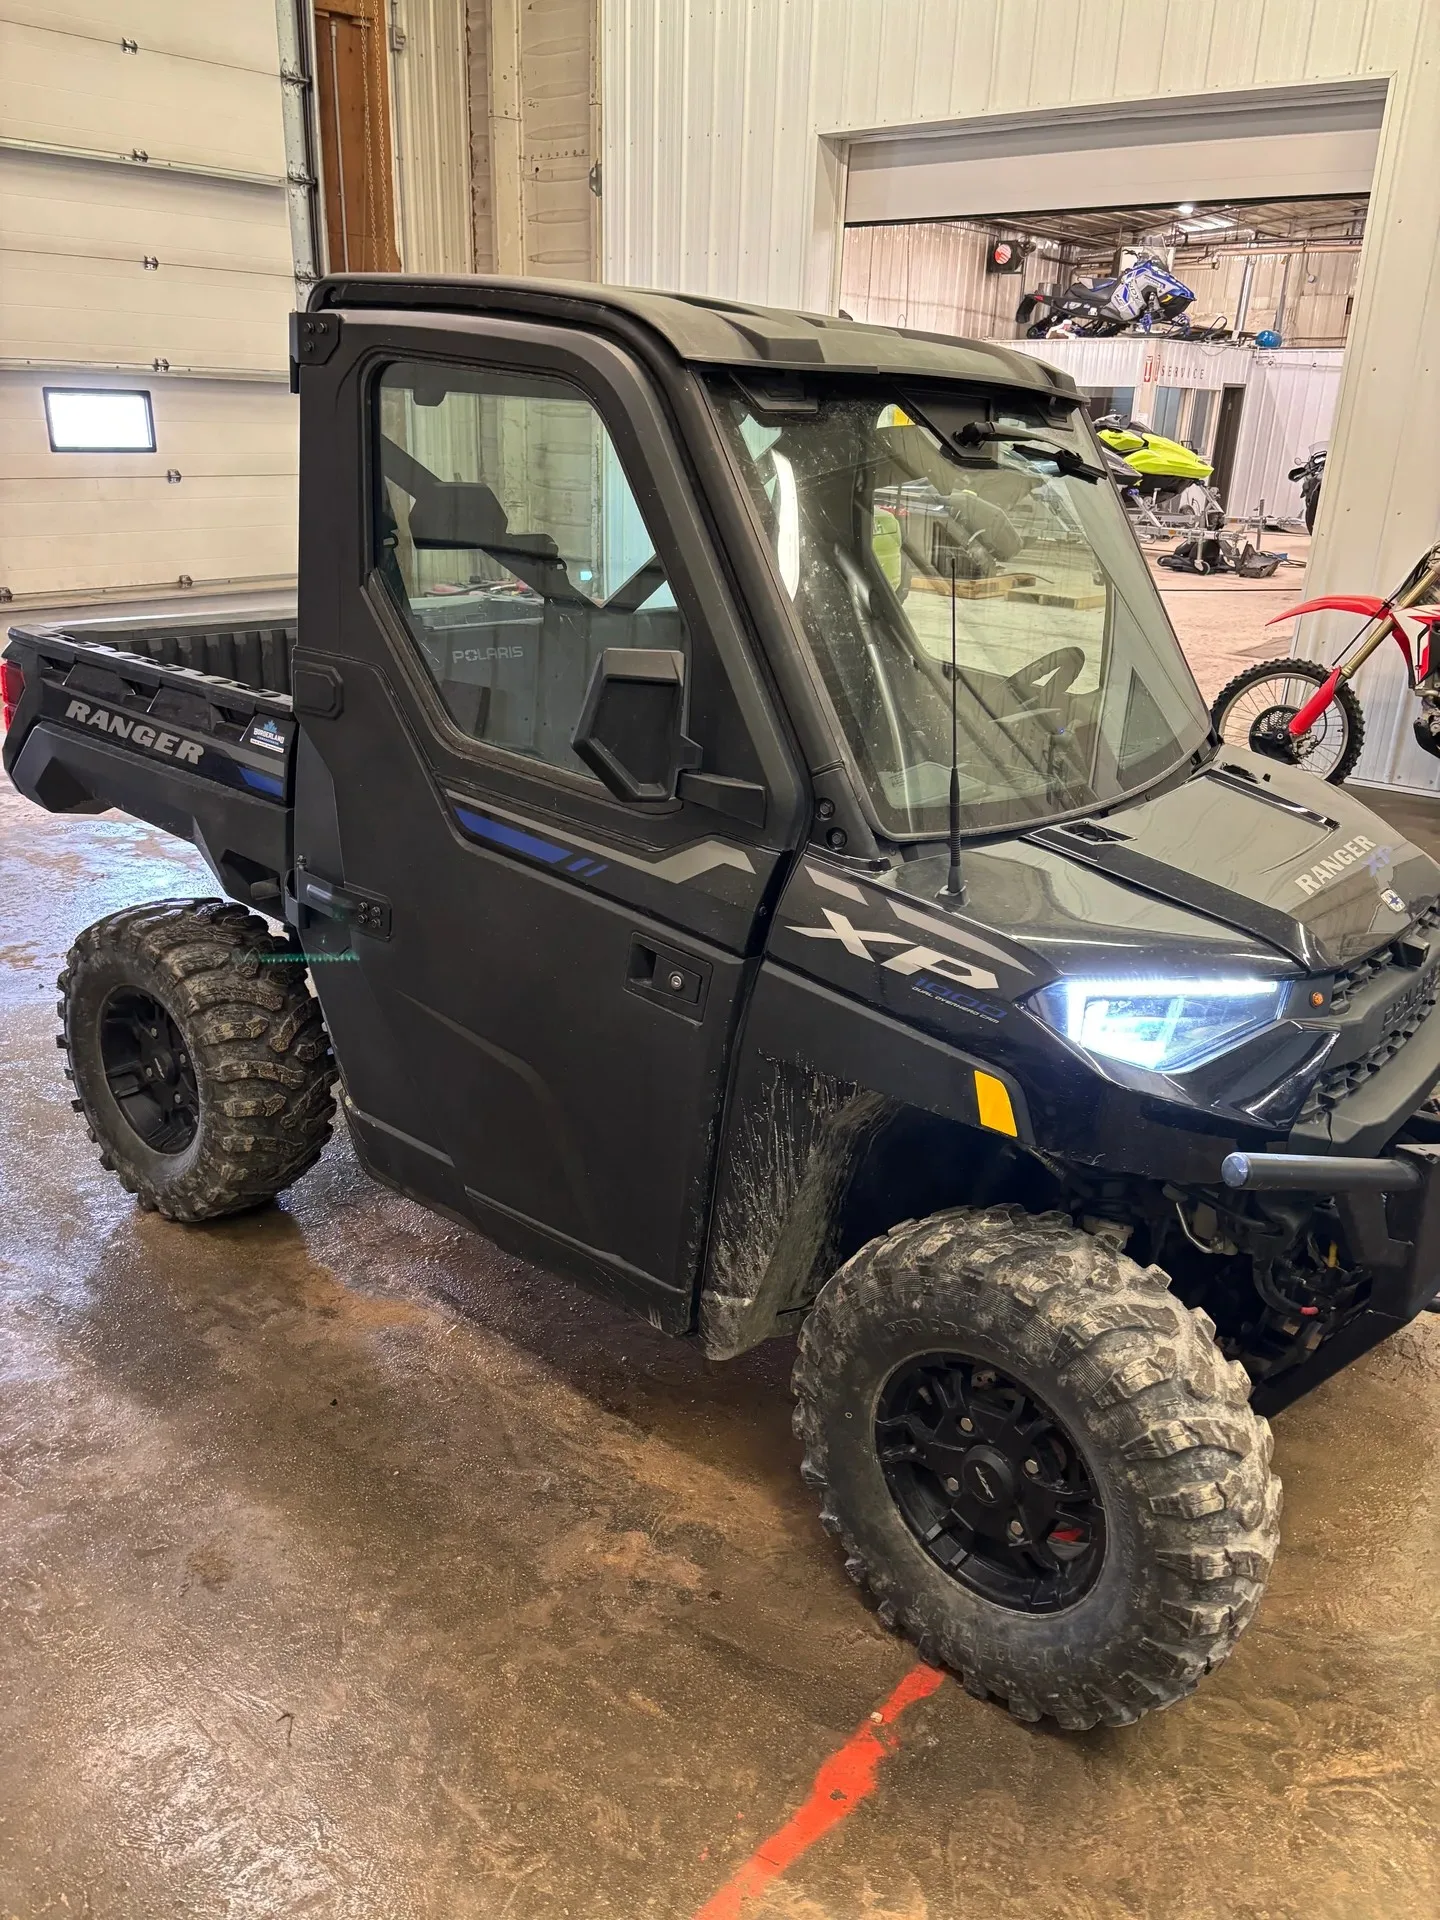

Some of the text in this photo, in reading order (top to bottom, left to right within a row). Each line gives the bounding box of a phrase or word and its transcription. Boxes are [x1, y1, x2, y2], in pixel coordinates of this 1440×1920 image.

[1161, 366, 1204, 380] SERVICE
[452, 646, 523, 664] POLARIS
[65, 700, 205, 765] RANGER
[1294, 835, 1377, 896] RANGER
[1362, 845, 1392, 877] XP
[784, 907, 1000, 990] XP
[912, 986, 1000, 1024] DUAL OVERHEAD CAM
[914, 977, 1008, 1019] 1000
